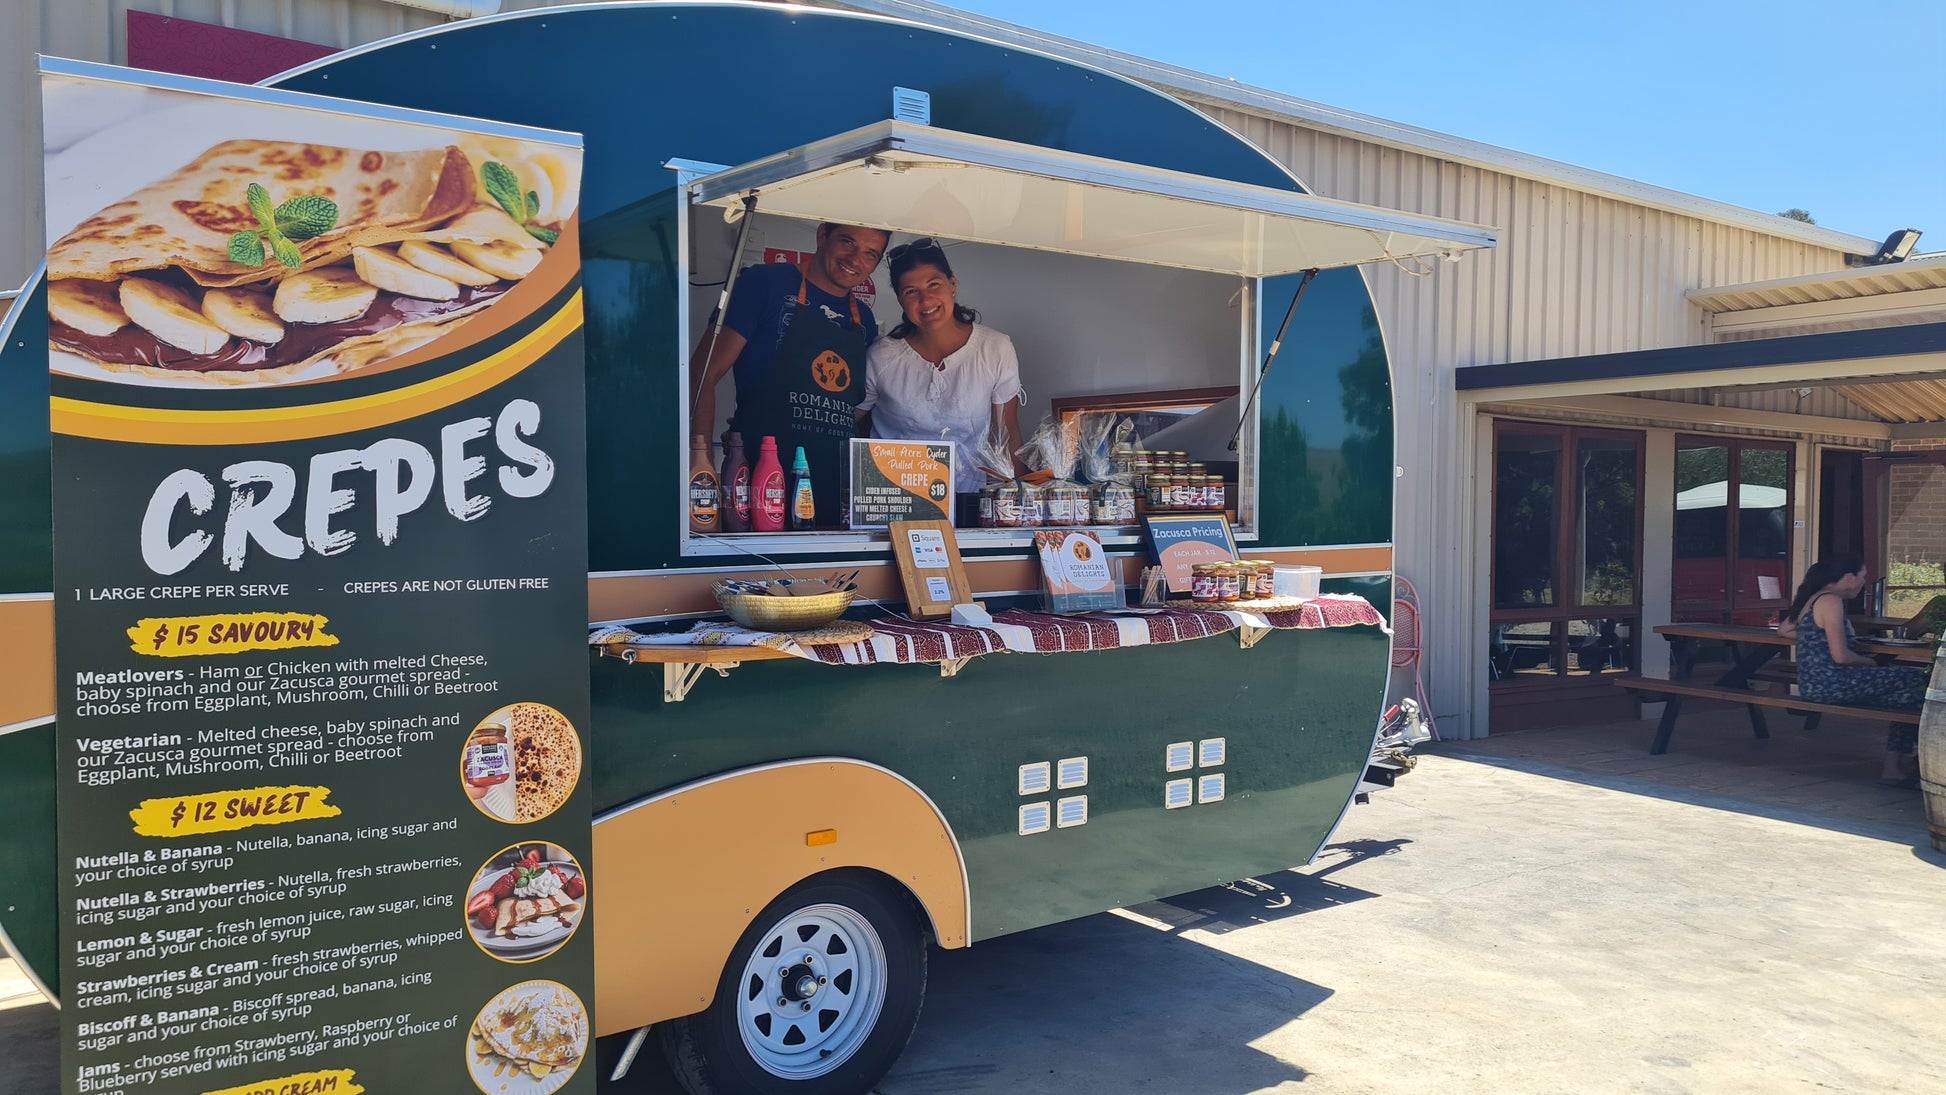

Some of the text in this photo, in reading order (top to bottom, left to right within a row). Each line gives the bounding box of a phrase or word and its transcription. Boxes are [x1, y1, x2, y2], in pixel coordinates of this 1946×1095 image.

[874, 445, 896, 457] Small
[926, 447, 948, 461] Cyder
[888, 459, 939, 471] Pulled Pork
[141, 398, 555, 576] CREPES
[881, 487, 901, 495] INFUSED
[901, 473, 928, 486] CREPE
[930, 484, 945, 496] $18
[854, 496, 872, 504] PULLED
[873, 496, 887, 504] PORK
[855, 505, 868, 513] WITH
[869, 505, 888, 513] MELTED
[1153, 527, 1223, 538] Zacusca Pricing
[75, 578, 549, 601] 1 LARGE CREPE PER SERVE CREPES ARE NOT GLUTEN FREE
[177, 624, 200, 646] 15
[208, 619, 314, 644] SAVOURY
[76, 654, 488, 686] Meatlovers Ham or Chicken with melted Cheese,
[76, 667, 461, 705] baby spinach and our Zacusca gourmet spread
[76, 680, 498, 717] choose from Eggplant, Mushroom, Chilli or Beetroot
[77, 712, 460, 754] Vegetarian Melted cheese, baby spinach and
[77, 729, 434, 768] our Zacusca gourmet spread choose from
[78, 746, 402, 786] Eggplant, Mushroom, Chilli or Beetroot
[194, 801, 217, 823] 12
[224, 792, 310, 819] SWEET
[76, 817, 457, 870] Nutella & Banana Nutella, banana, icing sugar and
[76, 856, 462, 911] Nutella & Strawberries Nutella, fresh strawberries,
[77, 894, 454, 953] Lemon & Sugar fresh lemon juice, raw sugar, icing
[77, 928, 463, 995] Strawberries & Cream fresh strawberries, whipped
[77, 953, 398, 1009] cream, icing sugar and your choice of syrup
[78, 972, 432, 1037] Biscoff & Banana Biscoff spread, banana, icing
[78, 1013, 411, 1080] Jams choose from Strawberry, Raspberry or
[78, 1063, 158, 1093] Blueberry
[160, 1054, 212, 1079] served
[215, 1048, 248, 1069] with
[252, 1041, 286, 1063] icing
[289, 1040, 330, 1057] sugar
[333, 1029, 360, 1048] and
[363, 1028, 395, 1047] your
[398, 1021, 440, 1037] choice
[444, 1015, 458, 1029] of
[280, 1076, 337, 1095] CREAM
